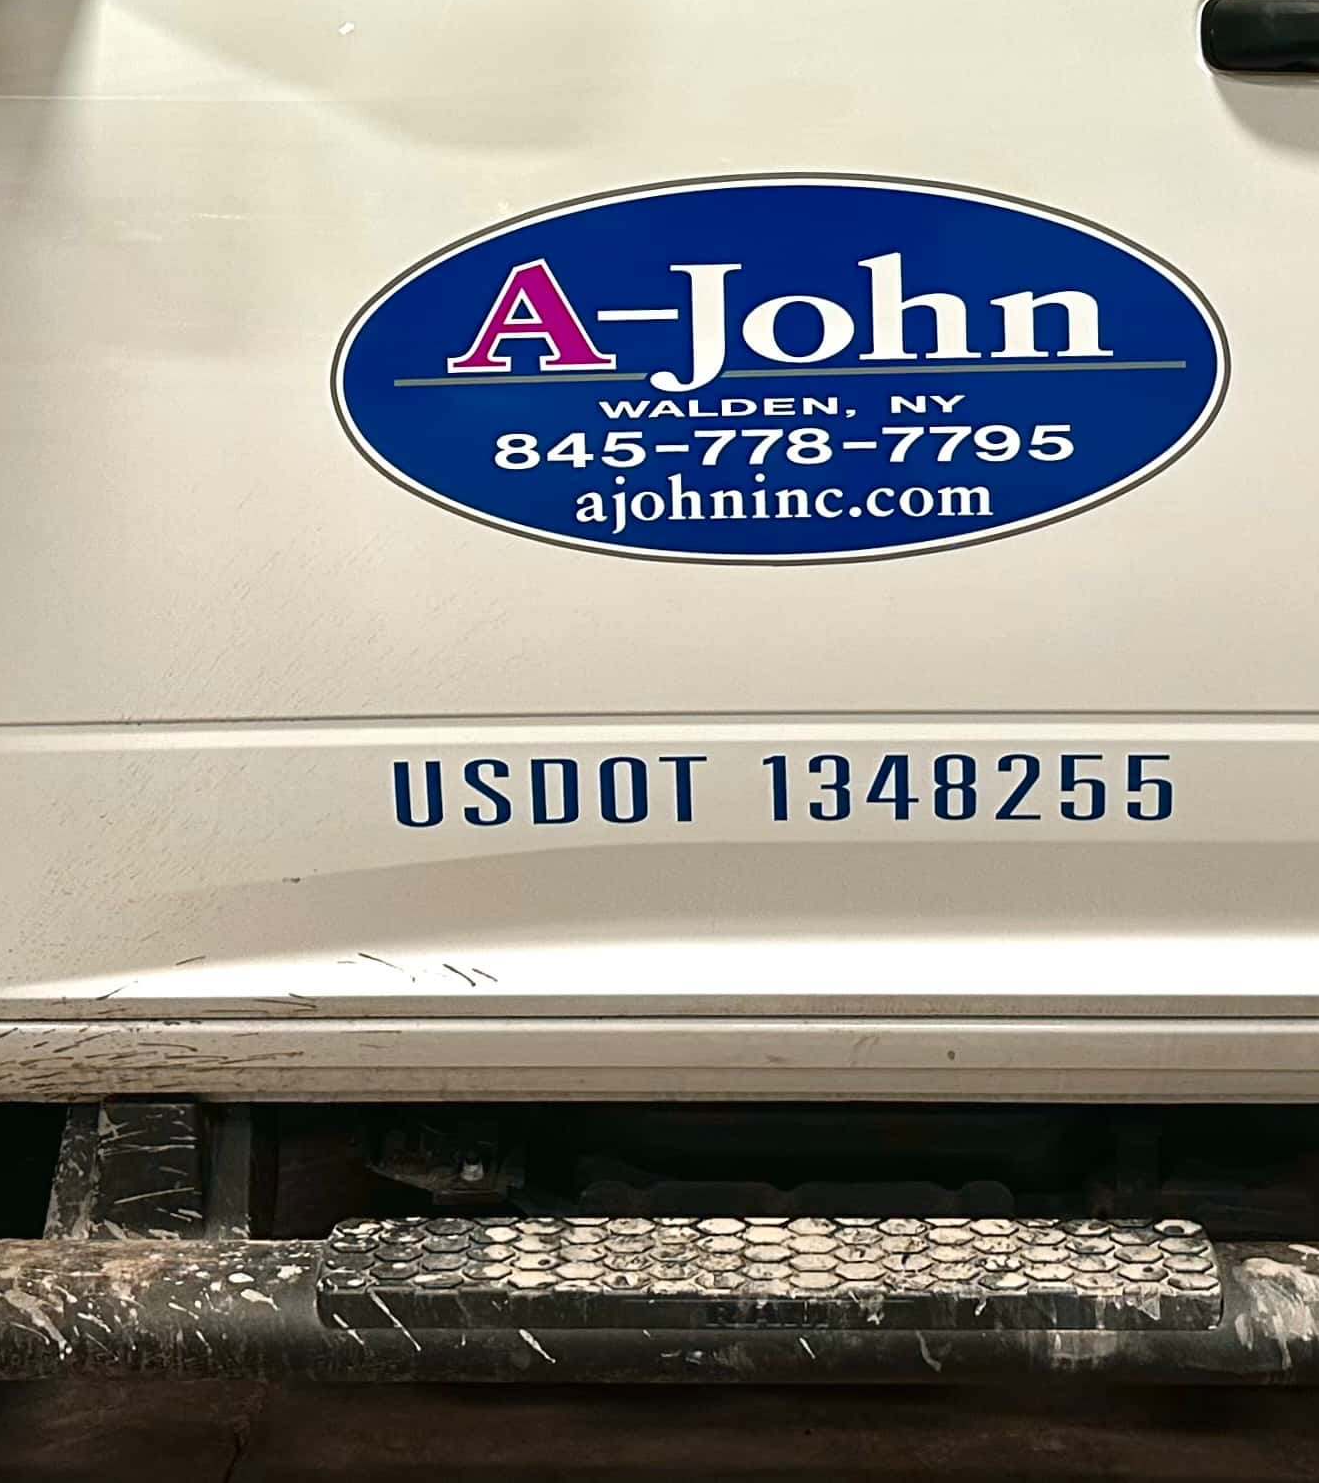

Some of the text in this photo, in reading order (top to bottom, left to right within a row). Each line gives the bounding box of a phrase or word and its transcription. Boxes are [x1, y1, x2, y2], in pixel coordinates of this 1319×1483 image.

[446, 251, 1115, 394] A-John
[598, 394, 968, 420] WALDEN, NY
[493, 424, 1076, 471] 845-778-7795
[573, 473, 994, 535] ajohninc.com
[393, 753, 1174, 828] USDOT 1348255
